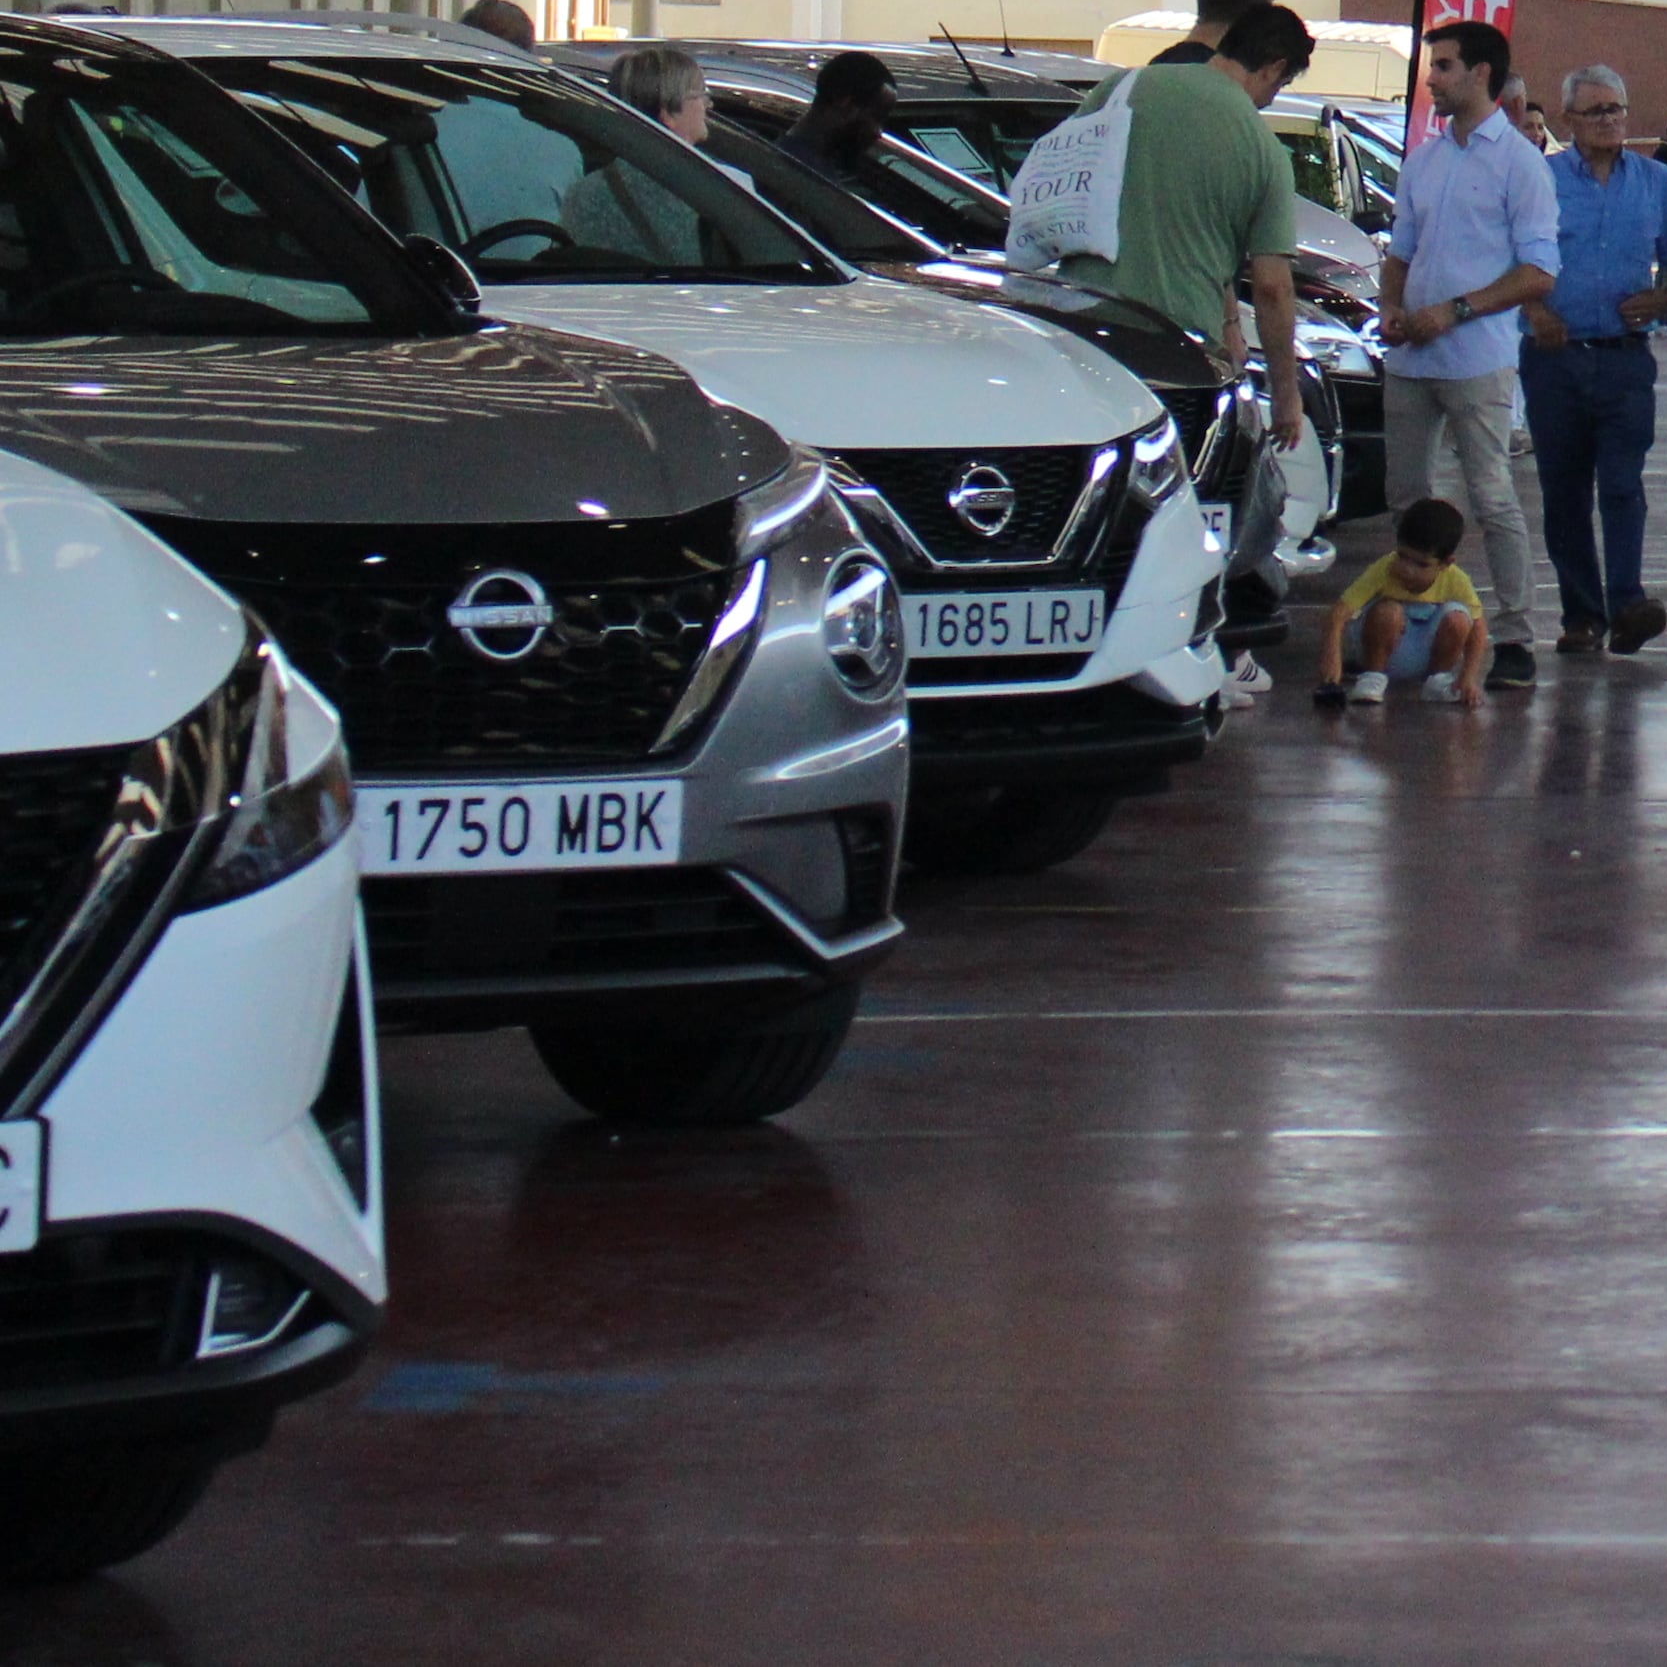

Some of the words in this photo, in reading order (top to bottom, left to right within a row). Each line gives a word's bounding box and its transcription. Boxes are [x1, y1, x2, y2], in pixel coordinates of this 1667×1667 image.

[1047, 220, 1089, 236] STAR
[918, 601, 1010, 648] 1685
[1024, 598, 1095, 646] LRJ
[384, 795, 531, 861] 1750
[556, 789, 667, 855] MBK
